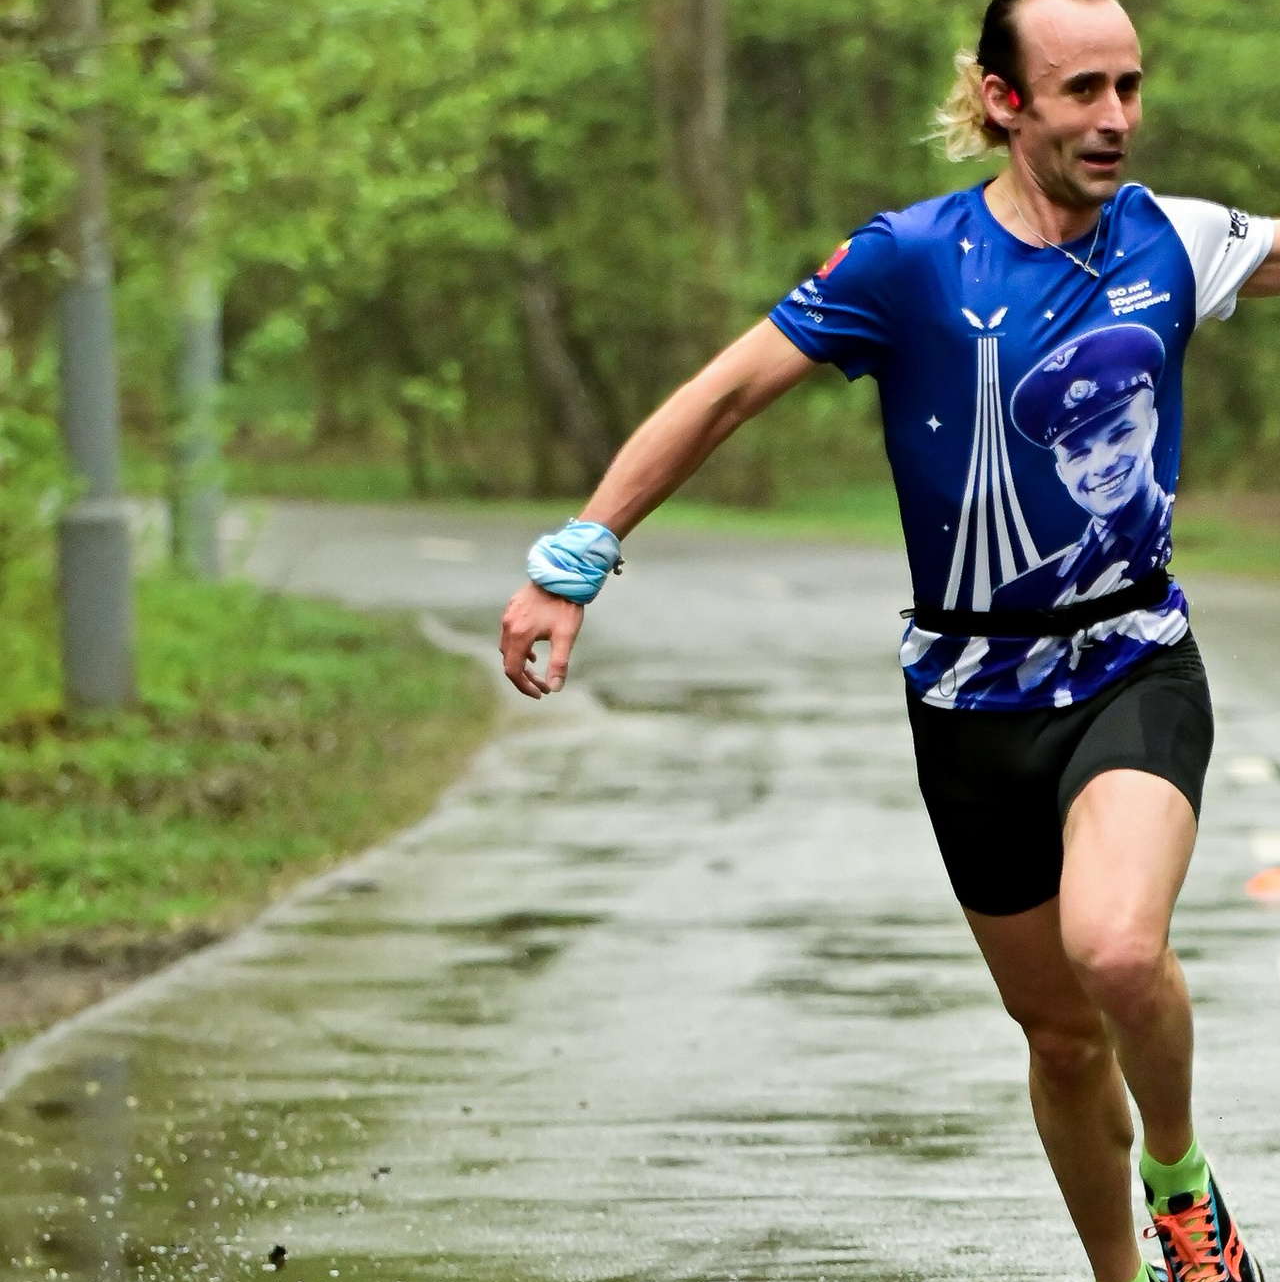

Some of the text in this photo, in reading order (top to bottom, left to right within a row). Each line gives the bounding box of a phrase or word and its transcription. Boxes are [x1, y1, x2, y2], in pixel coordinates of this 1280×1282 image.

[1106, 281, 1150, 299] 90 лет
[1110, 290, 1152, 308] Юрию
[1113, 293, 1171, 316] Гагарину
